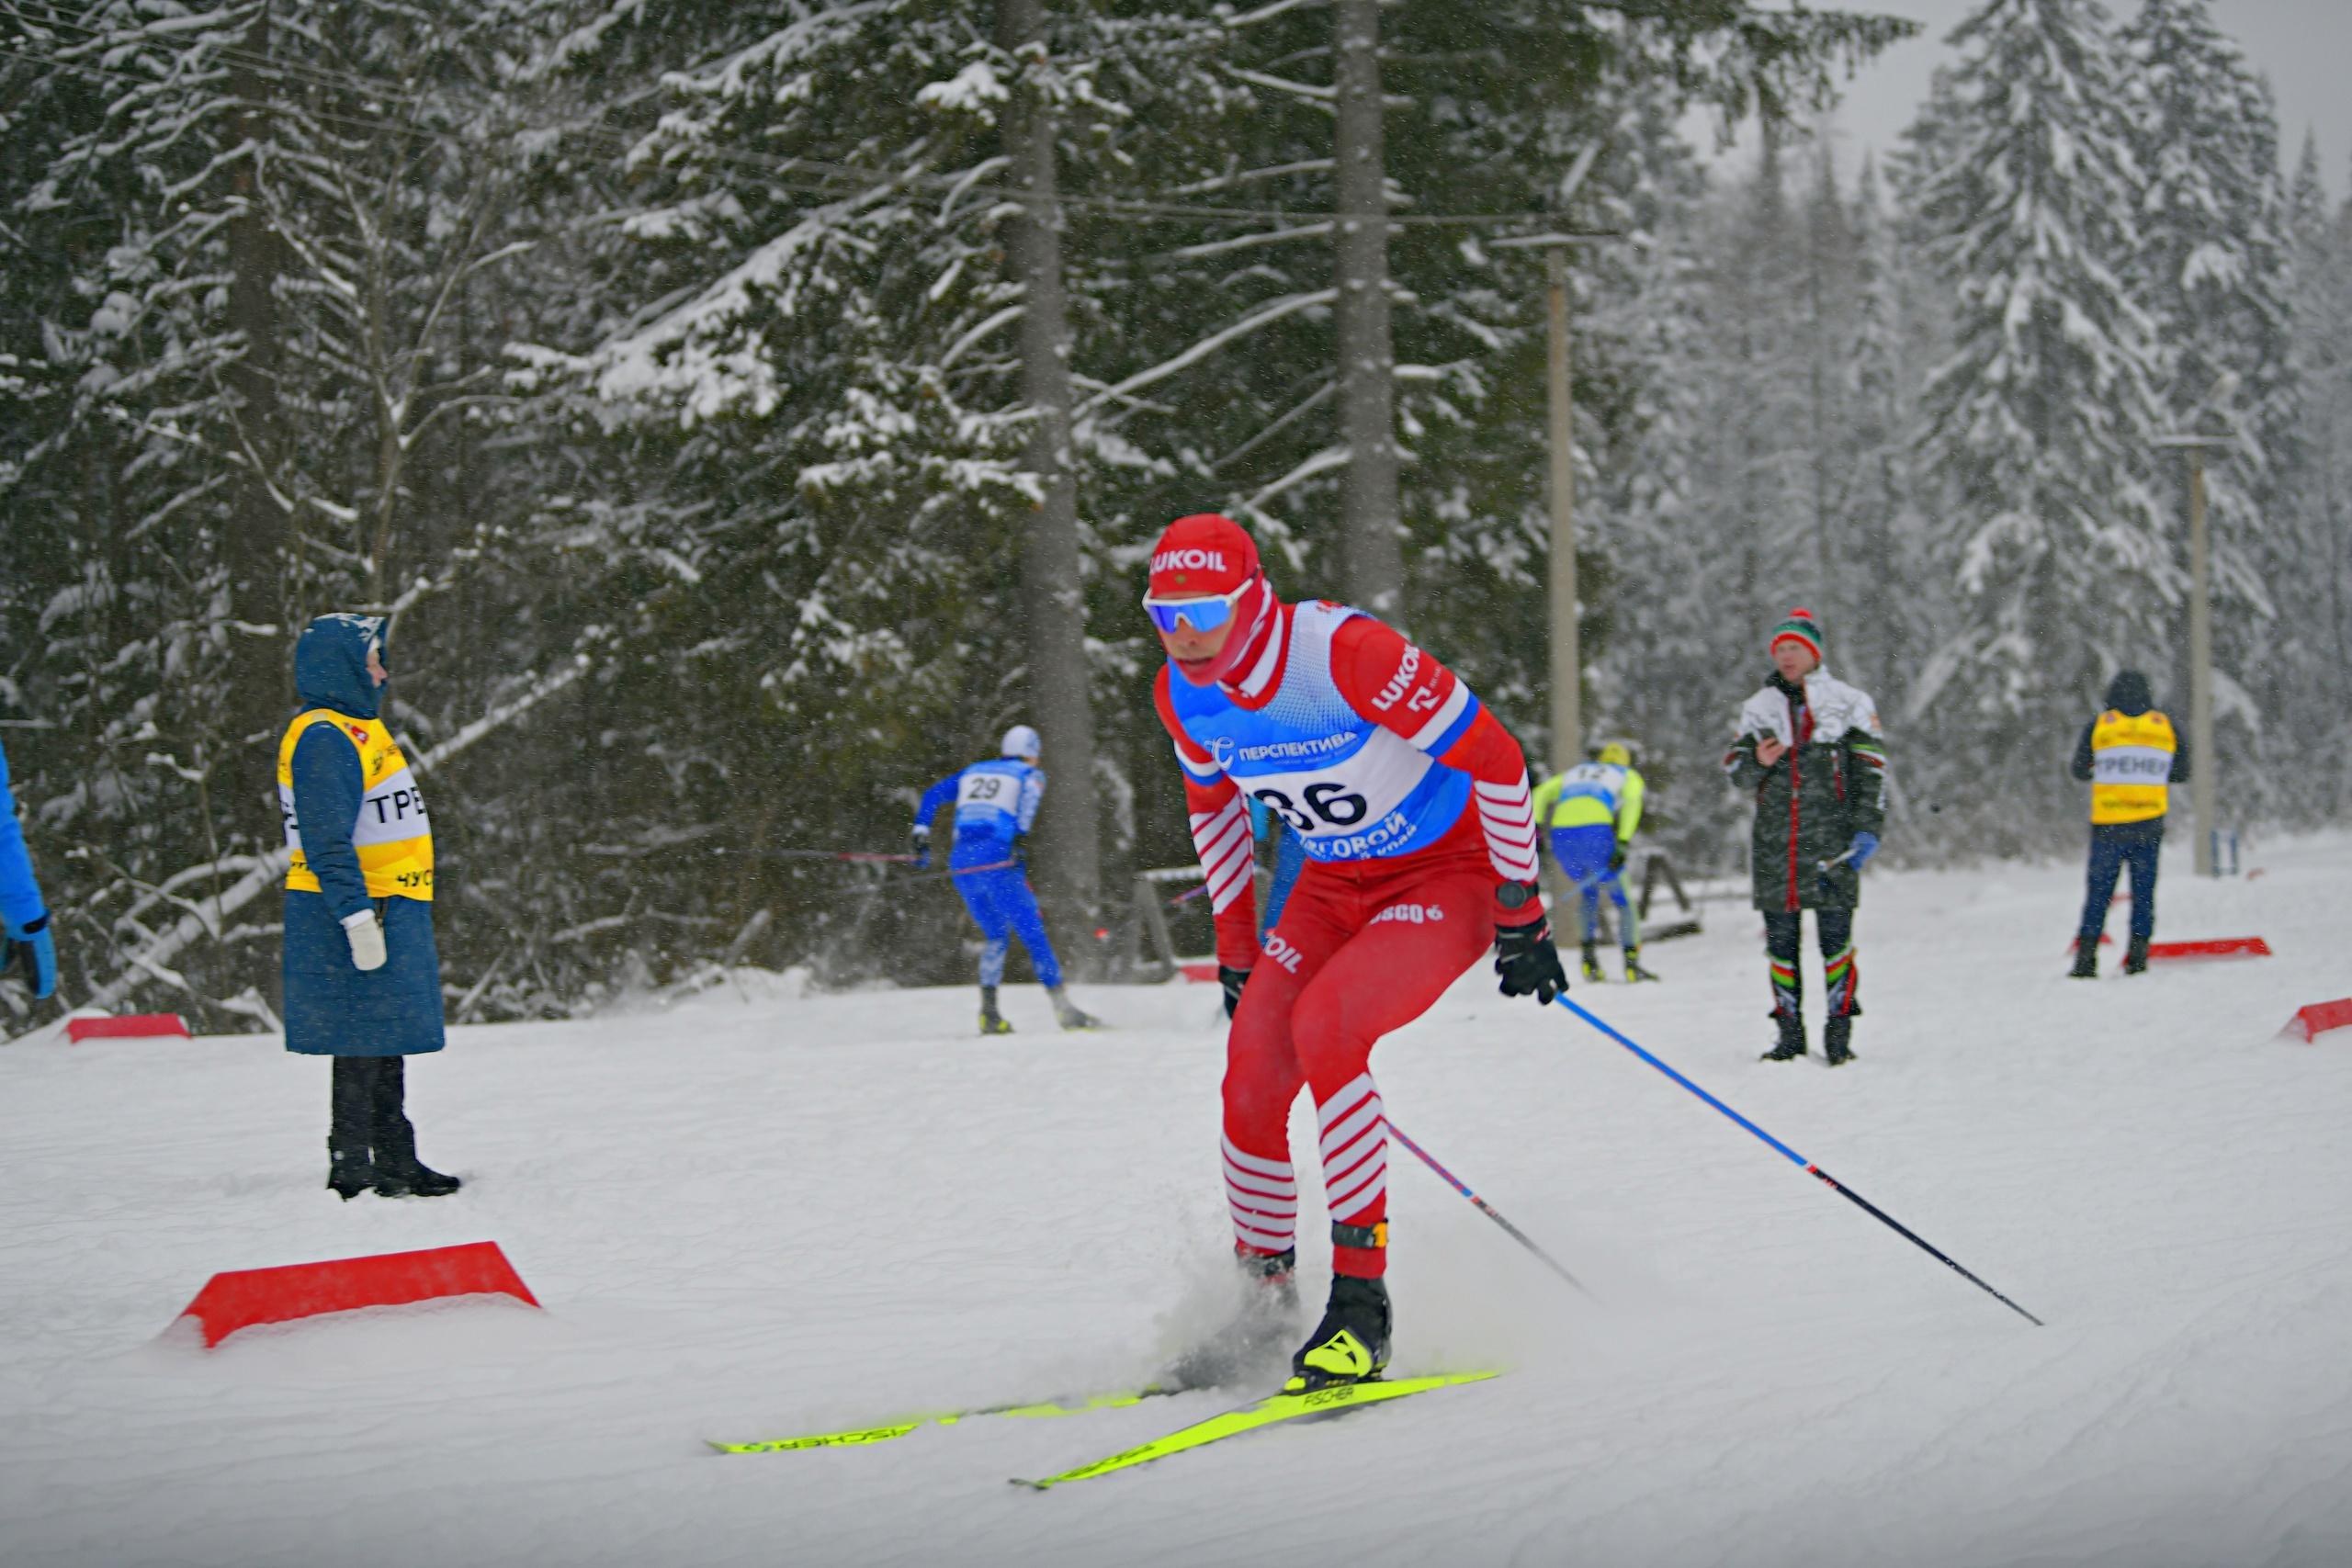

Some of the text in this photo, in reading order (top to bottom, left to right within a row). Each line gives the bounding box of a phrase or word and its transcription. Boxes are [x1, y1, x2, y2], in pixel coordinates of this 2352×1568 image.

[1238, 731, 1358, 761] ПЕРСПЕКТИВА
[967, 776, 1001, 800] 29
[1303, 1386, 1355, 1407] FISCHER
